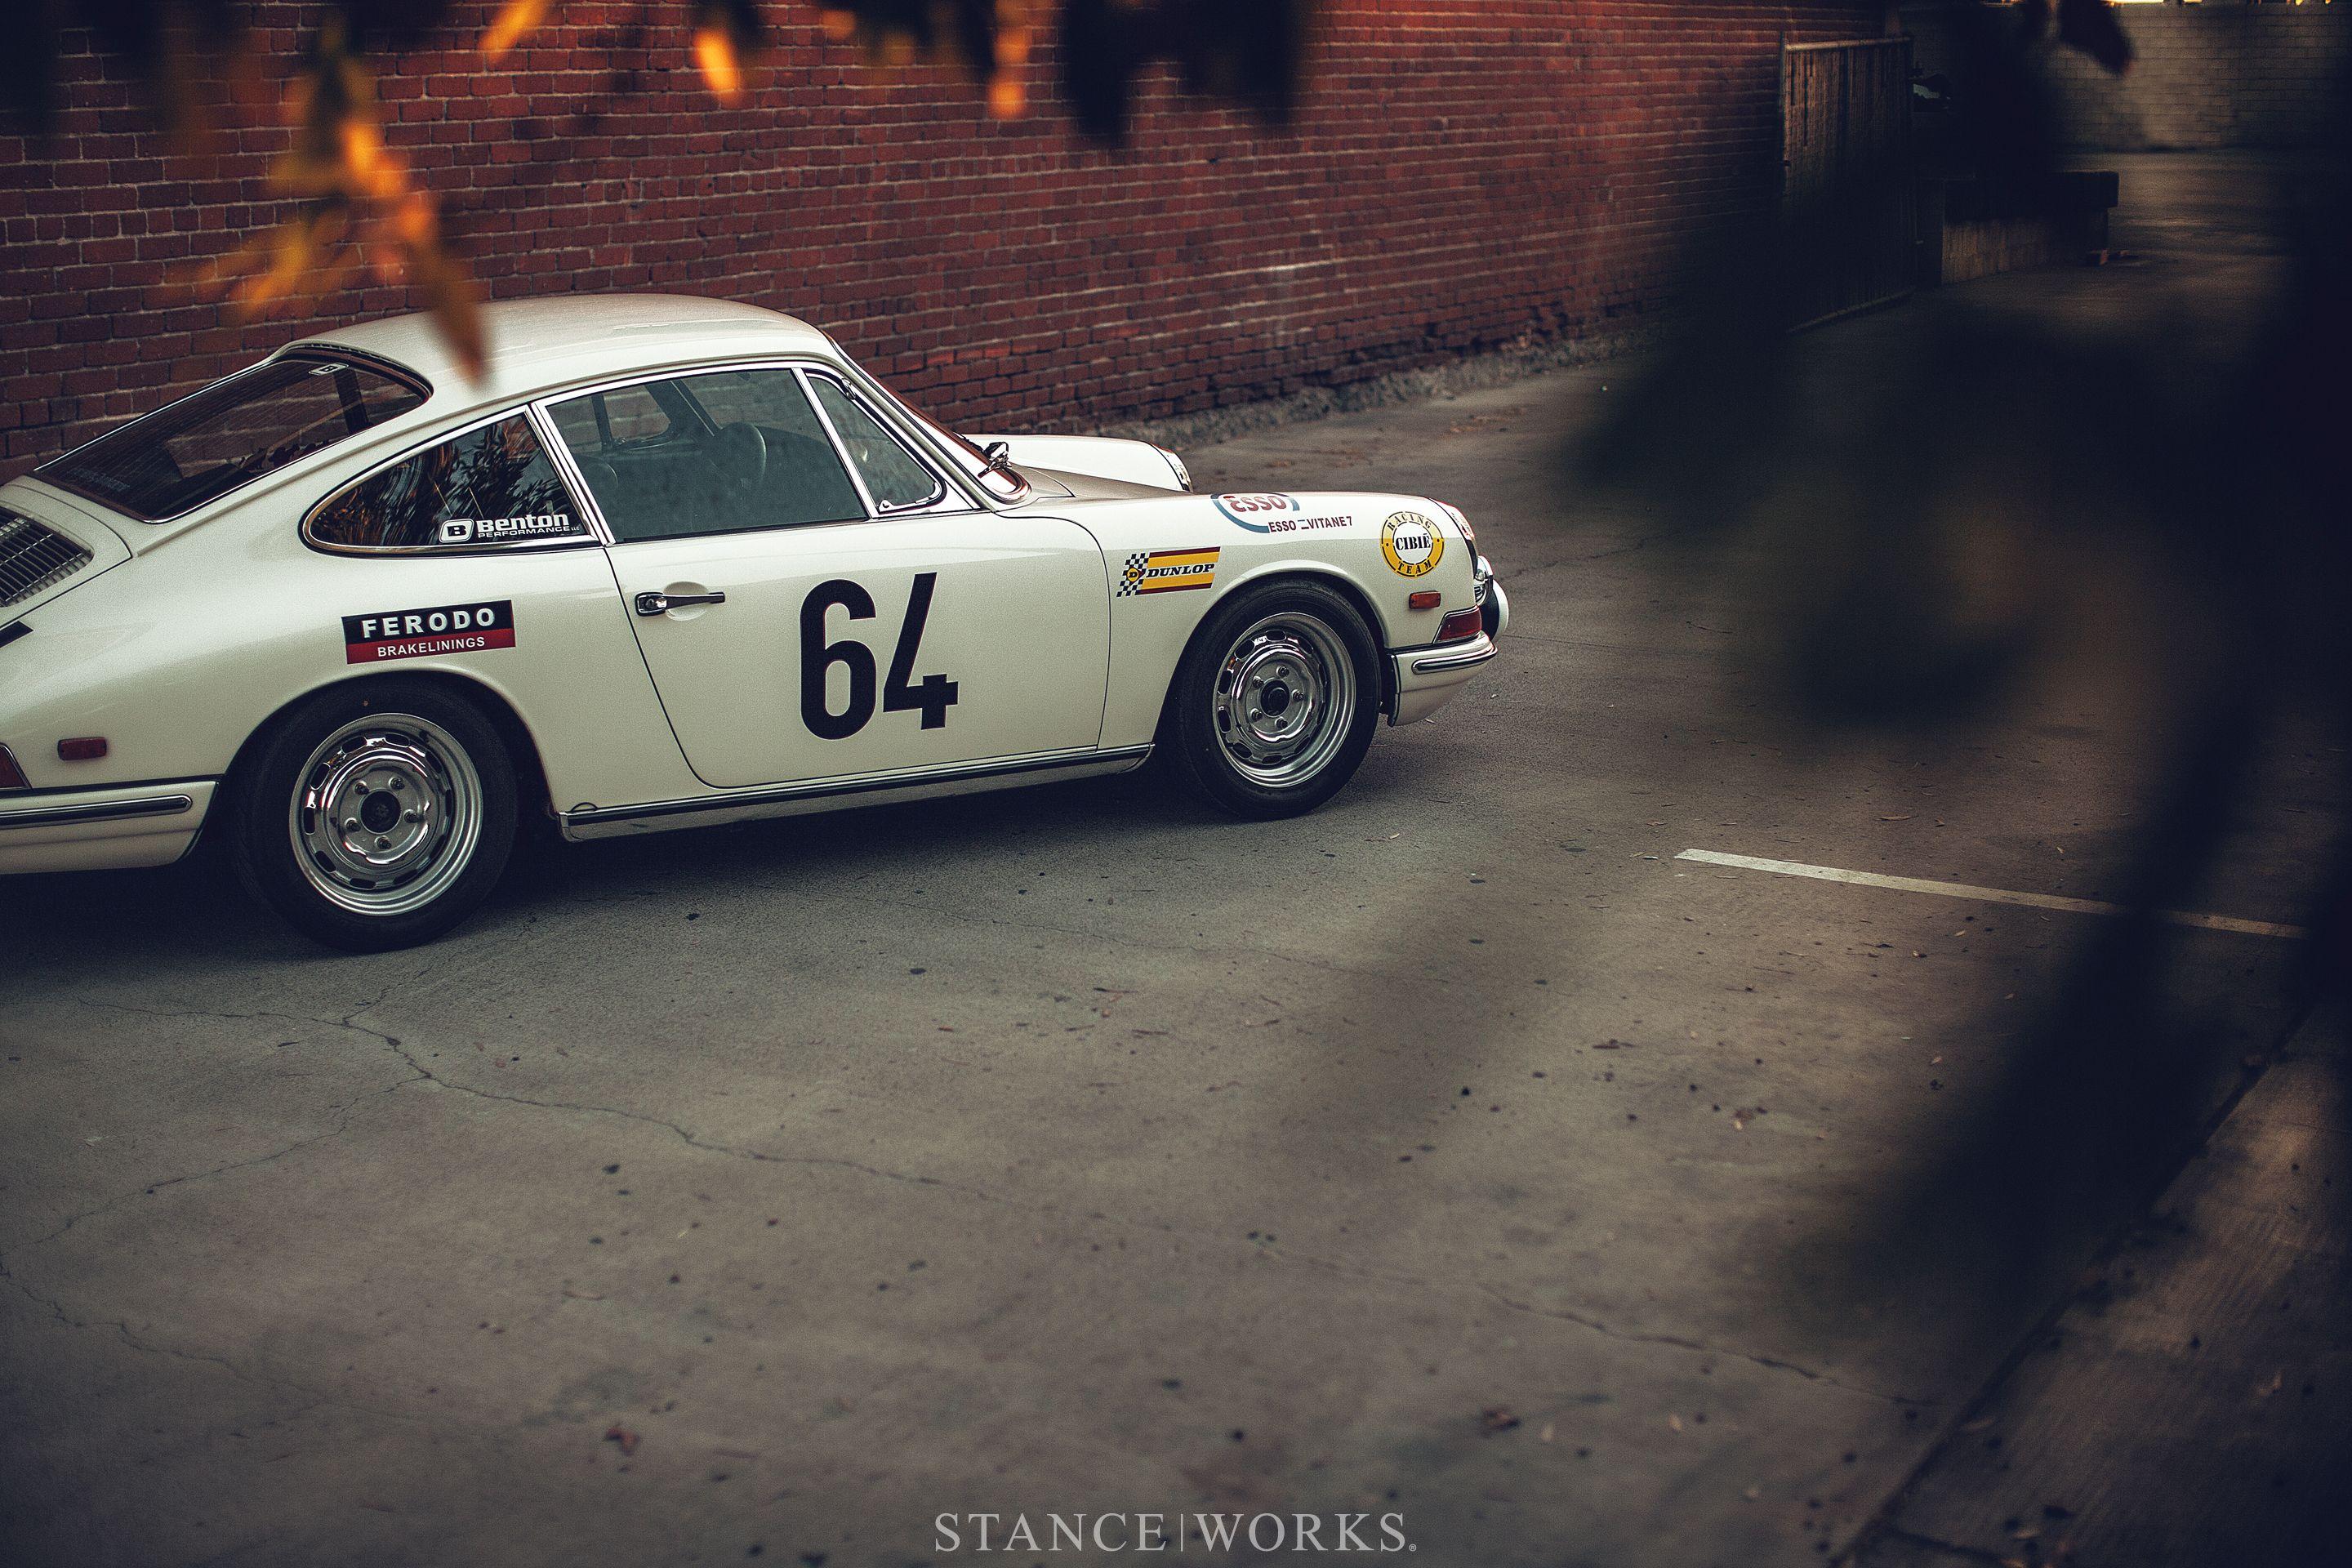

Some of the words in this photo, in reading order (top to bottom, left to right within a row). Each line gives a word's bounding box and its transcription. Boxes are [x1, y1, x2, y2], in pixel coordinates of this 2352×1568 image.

[476, 514, 569, 532] Benton
[1267, 519, 1297, 532] ESSO
[1387, 513, 1432, 532] RACING
[478, 526, 570, 538] PERFORMANCE
[1146, 564, 1215, 578] DUNLOP
[1397, 559, 1432, 575] TEAM
[361, 608, 496, 639] FERODO
[377, 637, 486, 657] BRAKELININGS
[800, 572, 958, 740] 64
